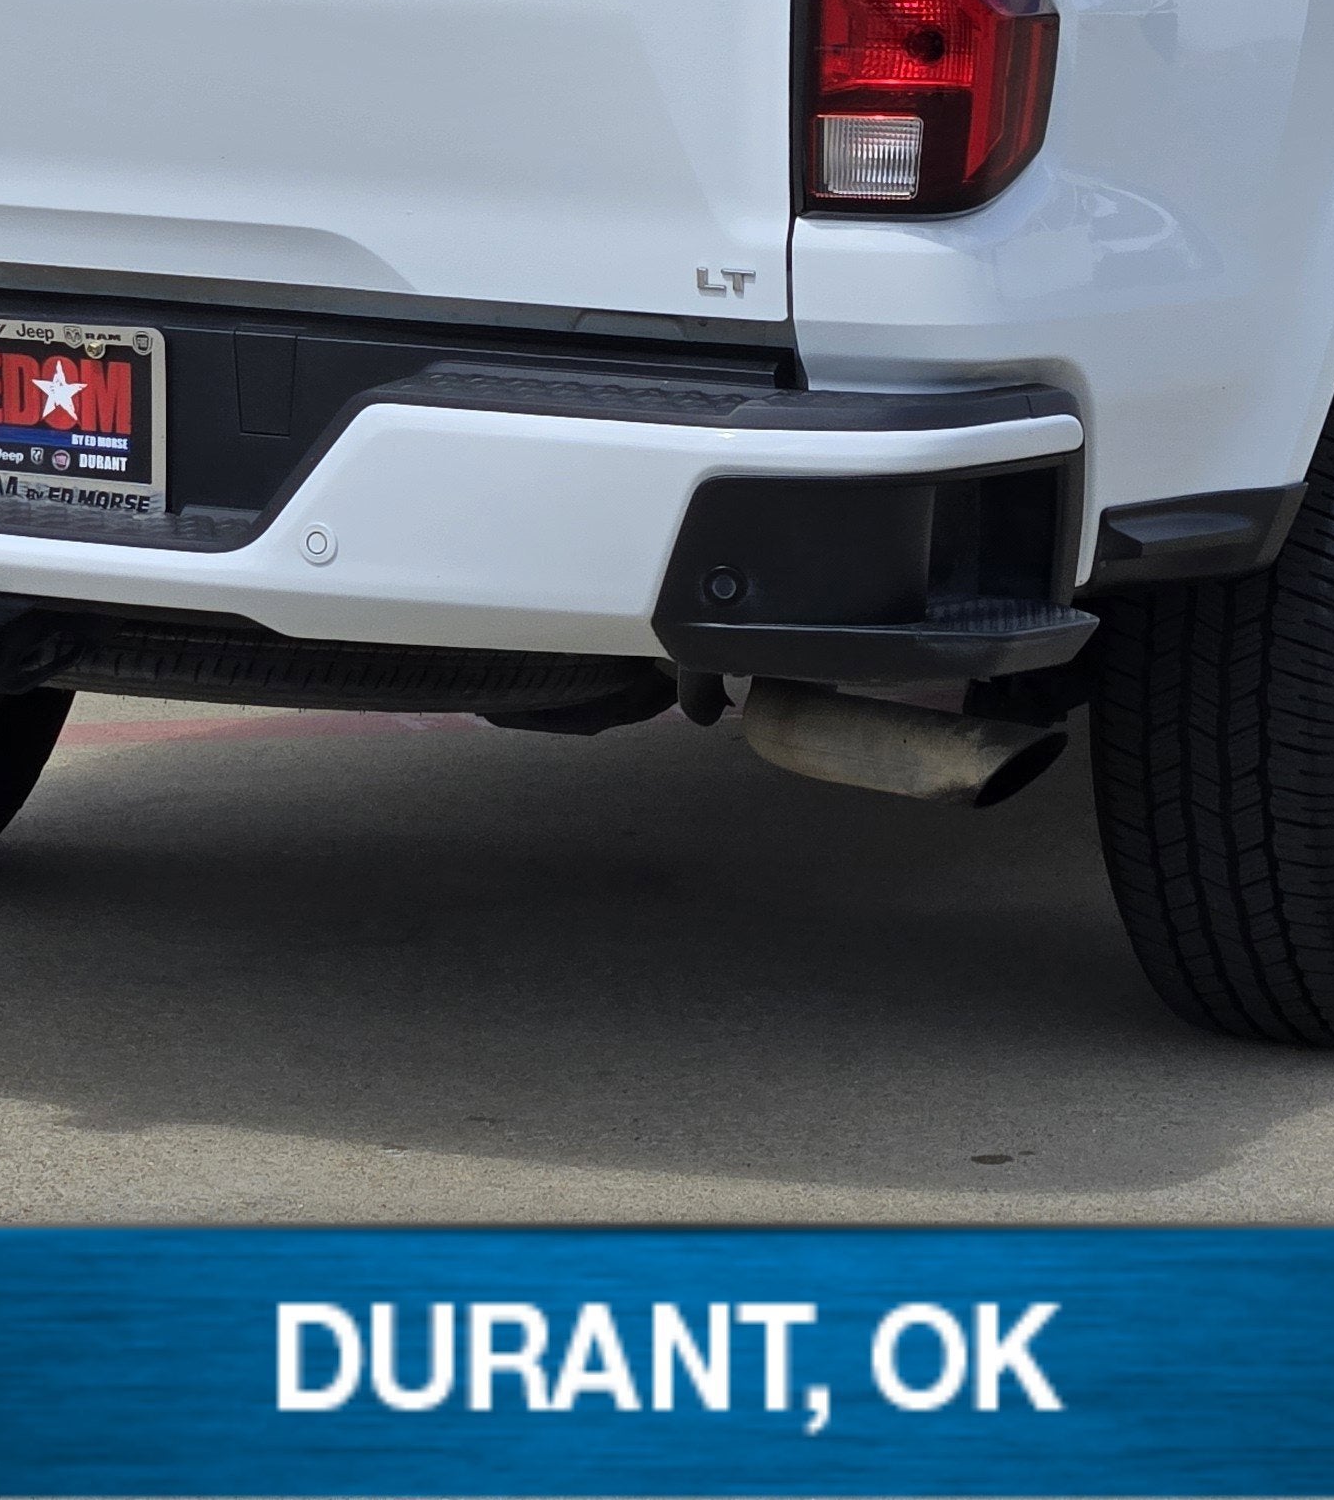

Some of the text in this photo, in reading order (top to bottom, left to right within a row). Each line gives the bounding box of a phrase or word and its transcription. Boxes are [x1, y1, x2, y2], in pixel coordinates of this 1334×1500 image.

[696, 266, 757, 295] LT
[16, 323, 55, 341] Jeep
[84, 332, 122, 342] RAM
[78, 453, 128, 472] DURANT
[48, 486, 74, 505] ED
[77, 488, 152, 513] MORSE
